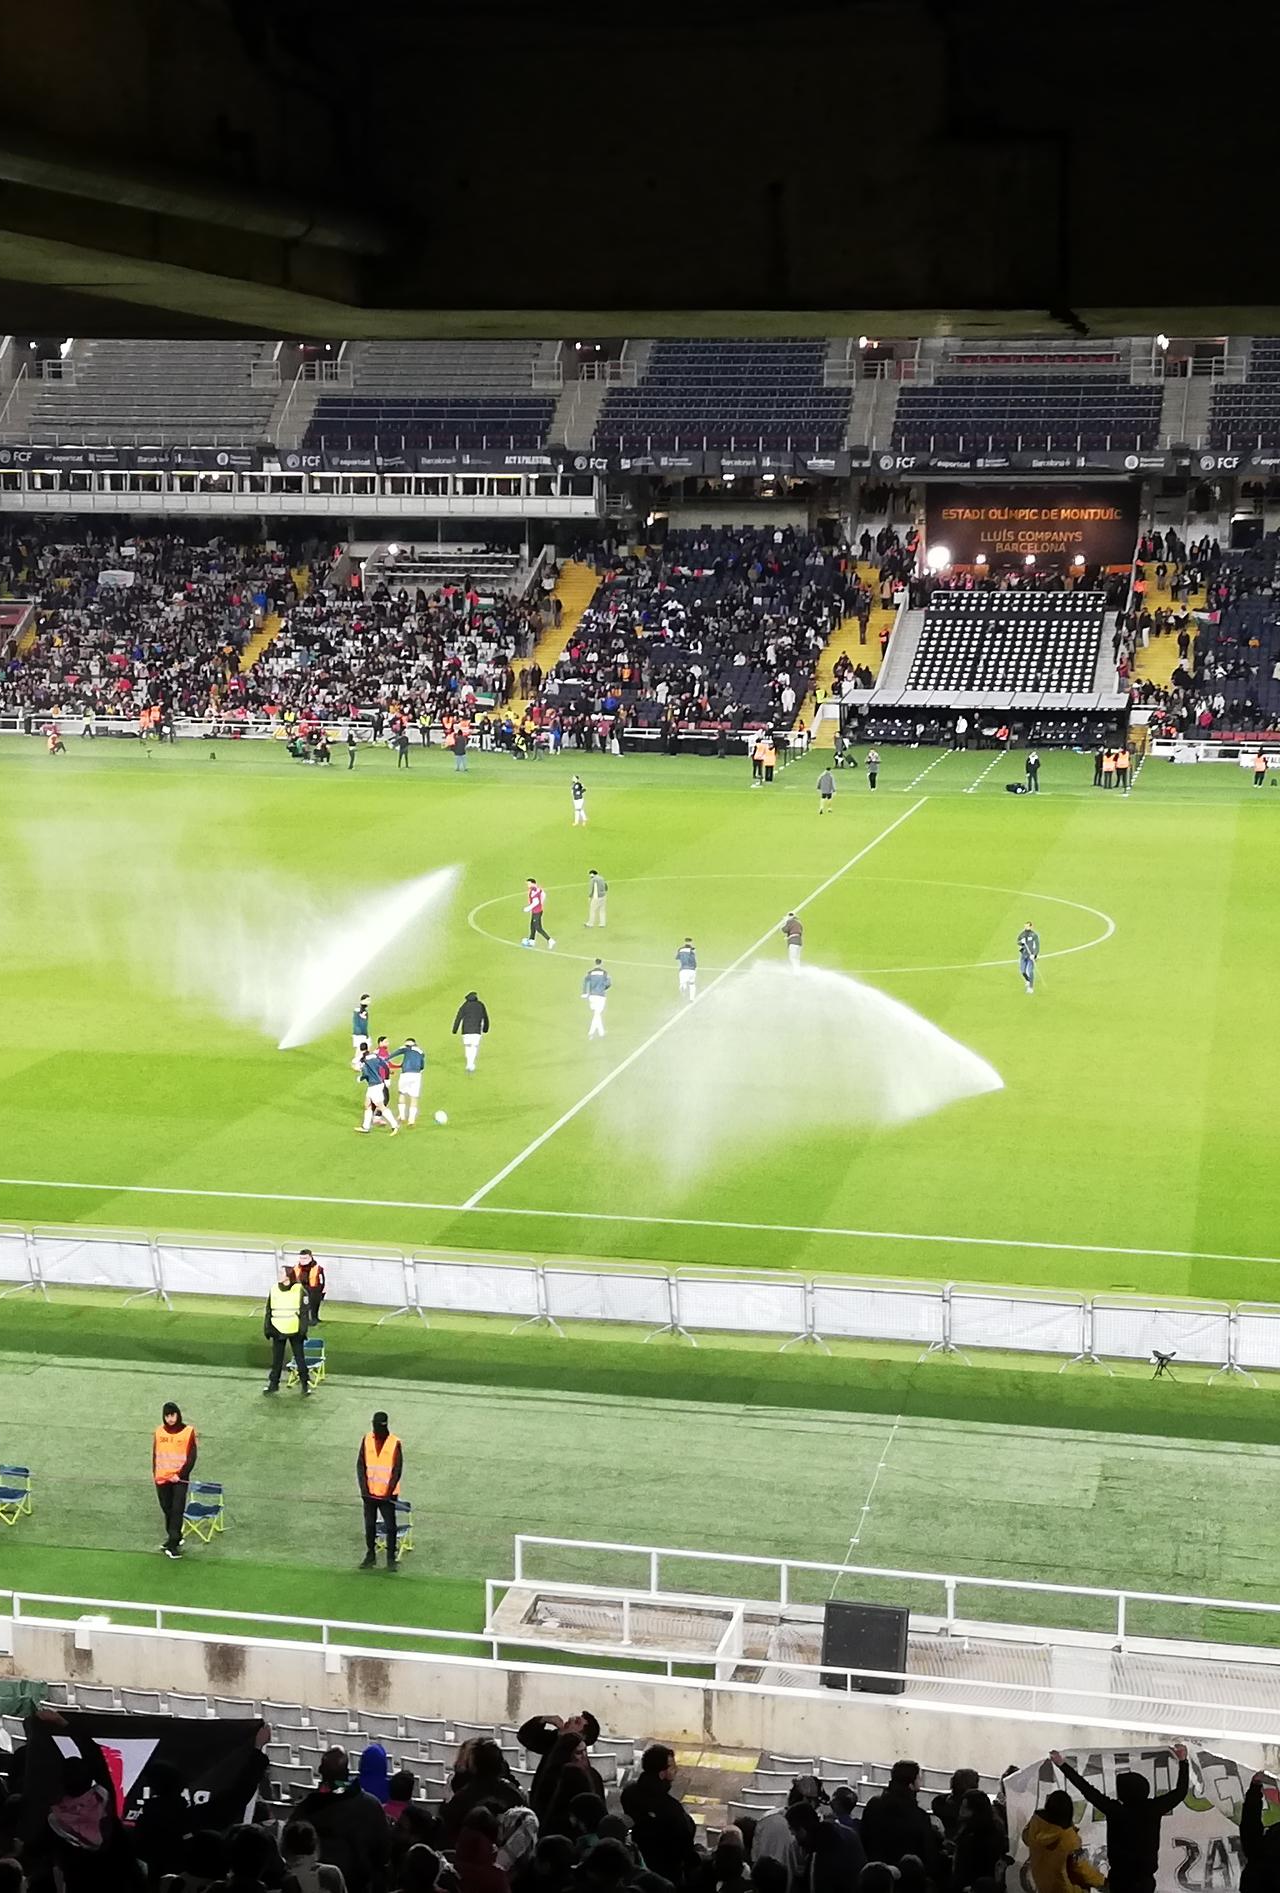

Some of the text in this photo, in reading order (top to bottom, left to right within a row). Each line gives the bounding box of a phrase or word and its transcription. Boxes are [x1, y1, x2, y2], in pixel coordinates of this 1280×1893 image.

[13, 451, 32, 461] FCF
[302, 456, 321, 466] FCF
[896, 457, 916, 469] FCF
[1217, 457, 1240, 469] FCF
[941, 508, 985, 520] ESTADI
[1041, 508, 1059, 520] DE
[980, 528, 1083, 543] LLUÍS COMPANYS
[995, 542, 1066, 553] BARCELONA
